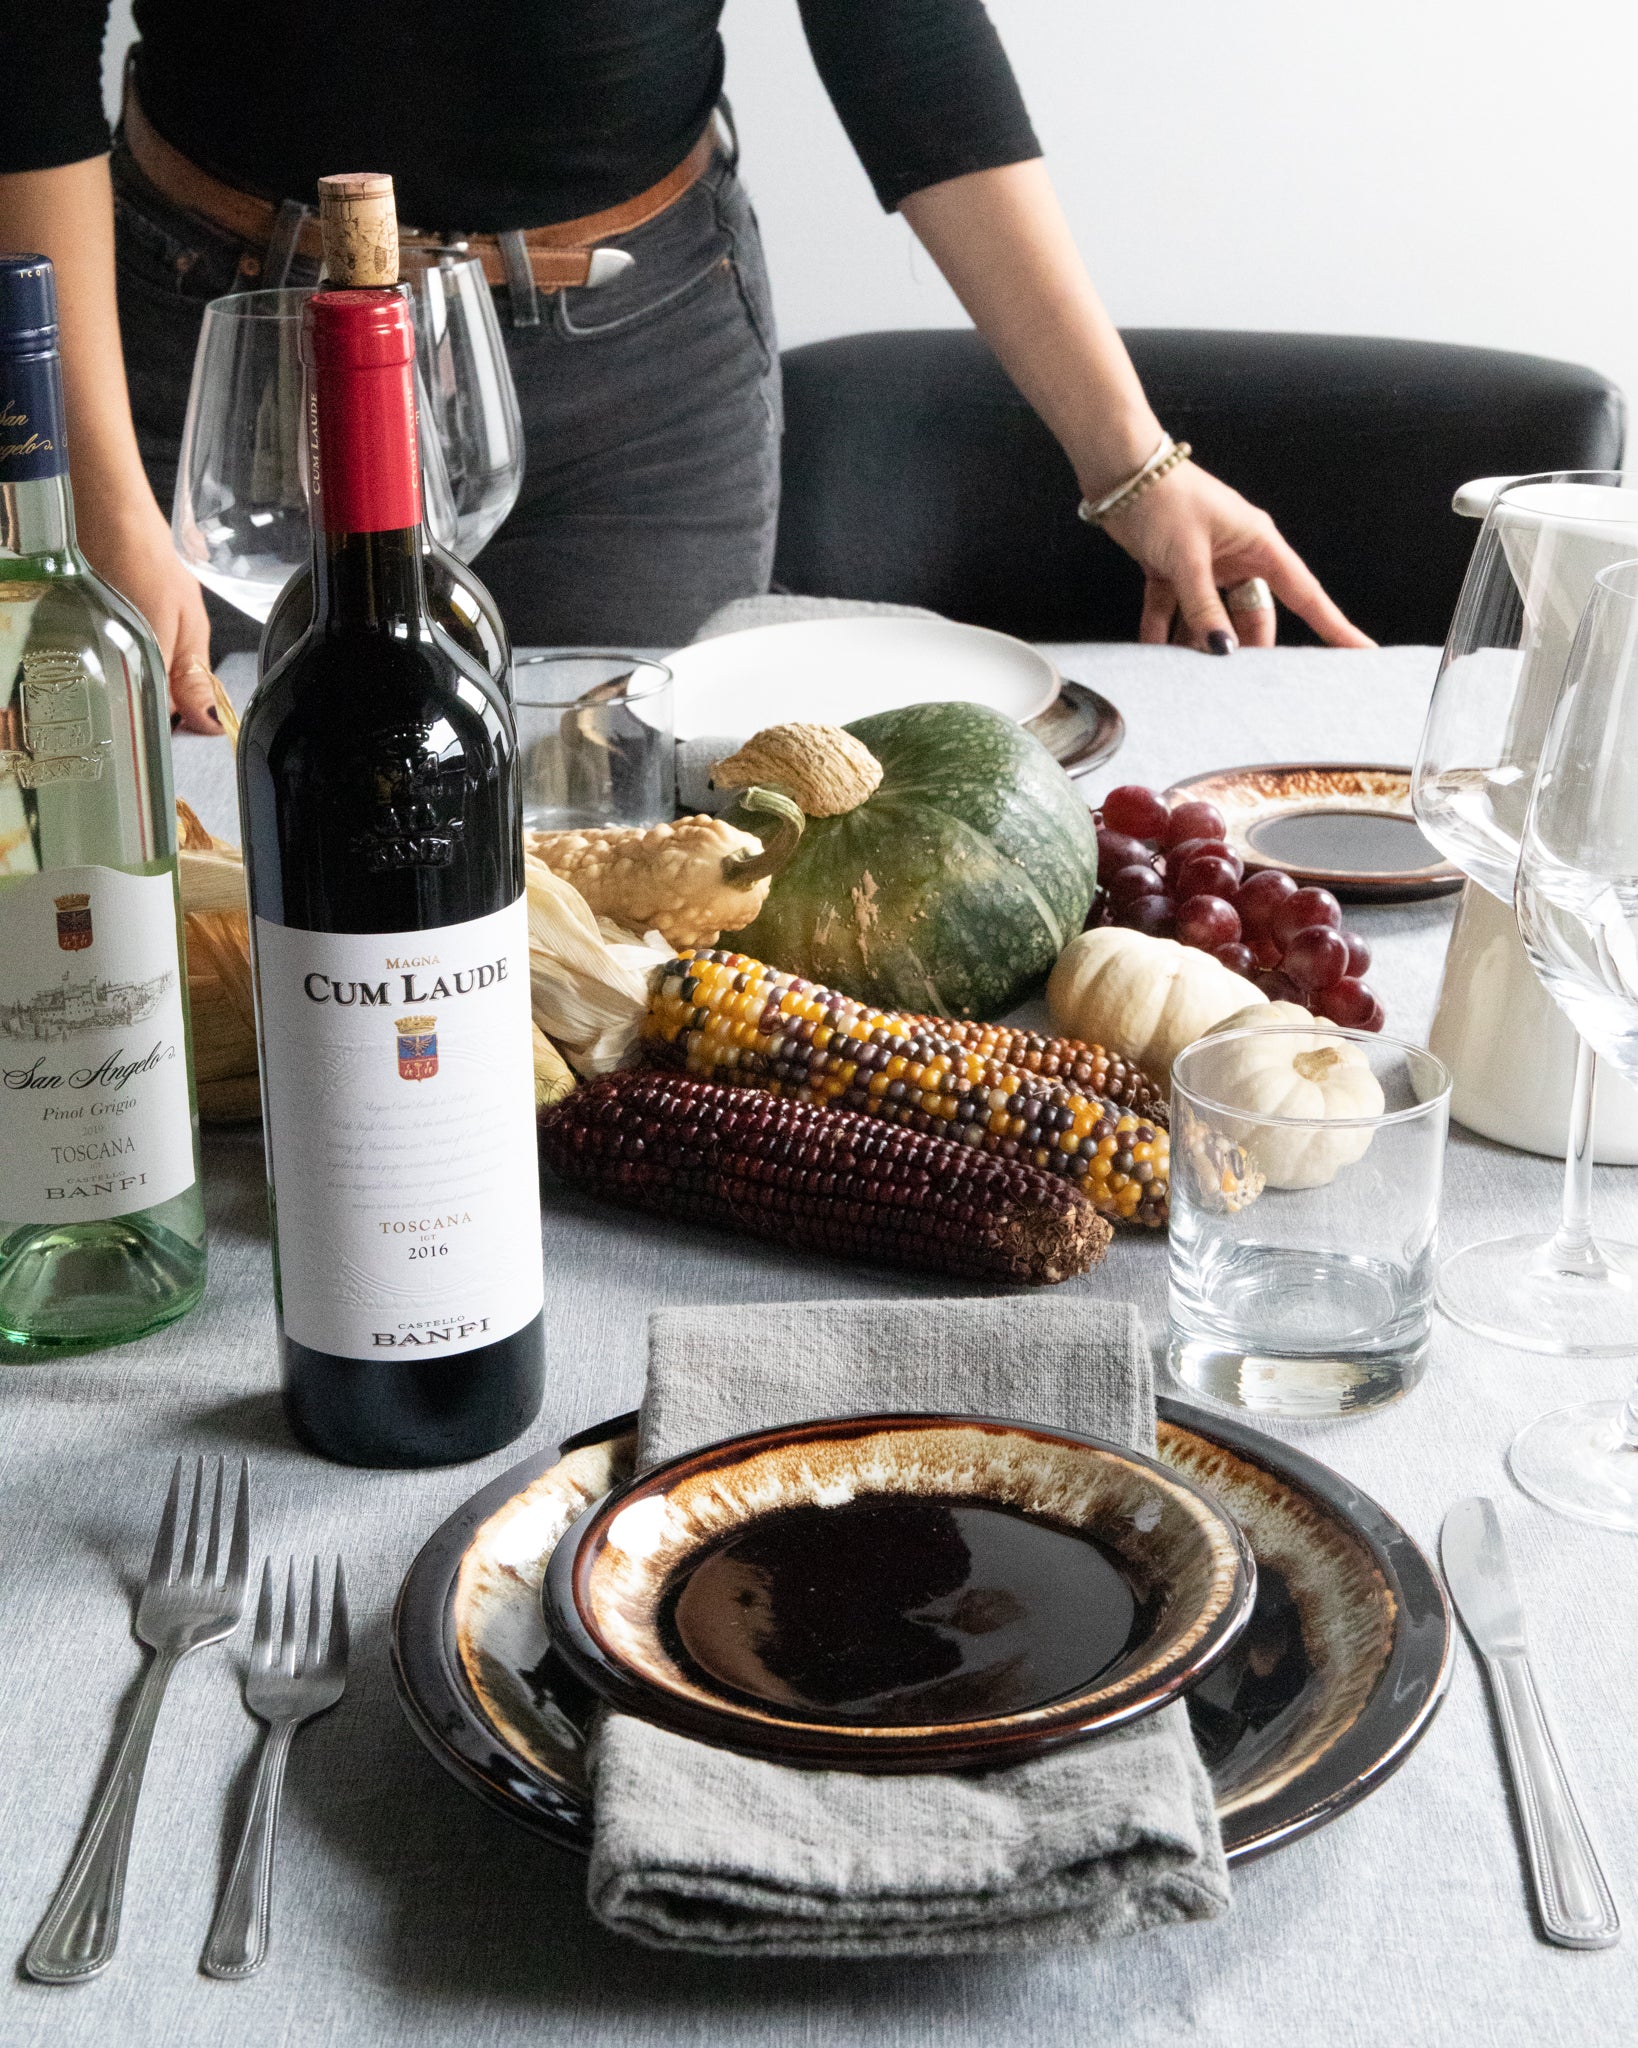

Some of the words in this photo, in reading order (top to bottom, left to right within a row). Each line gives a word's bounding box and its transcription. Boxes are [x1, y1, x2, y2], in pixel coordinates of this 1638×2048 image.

[310, 392, 319, 450] LAUDE
[312, 455, 321, 495] CUM
[385, 955, 441, 970] MAGNA
[304, 972, 392, 1007] CUM
[401, 957, 509, 1004] LAUDE
[2, 1056, 65, 1090] San
[68, 1040, 175, 1091] Angelo
[43, 1106, 84, 1121] Pinot
[90, 1095, 137, 1116] Grigio
[50, 1136, 136, 1164] TOSCANA
[44, 1172, 148, 1200] BANFI
[66, 1170, 126, 1184] CASTELLO
[378, 1211, 473, 1234] TOSCANA
[408, 1243, 449, 1260] 2016
[420, 1234, 437, 1242] IGT
[371, 1317, 491, 1347] BANFI
[397, 1315, 466, 1330] CASTELLO
